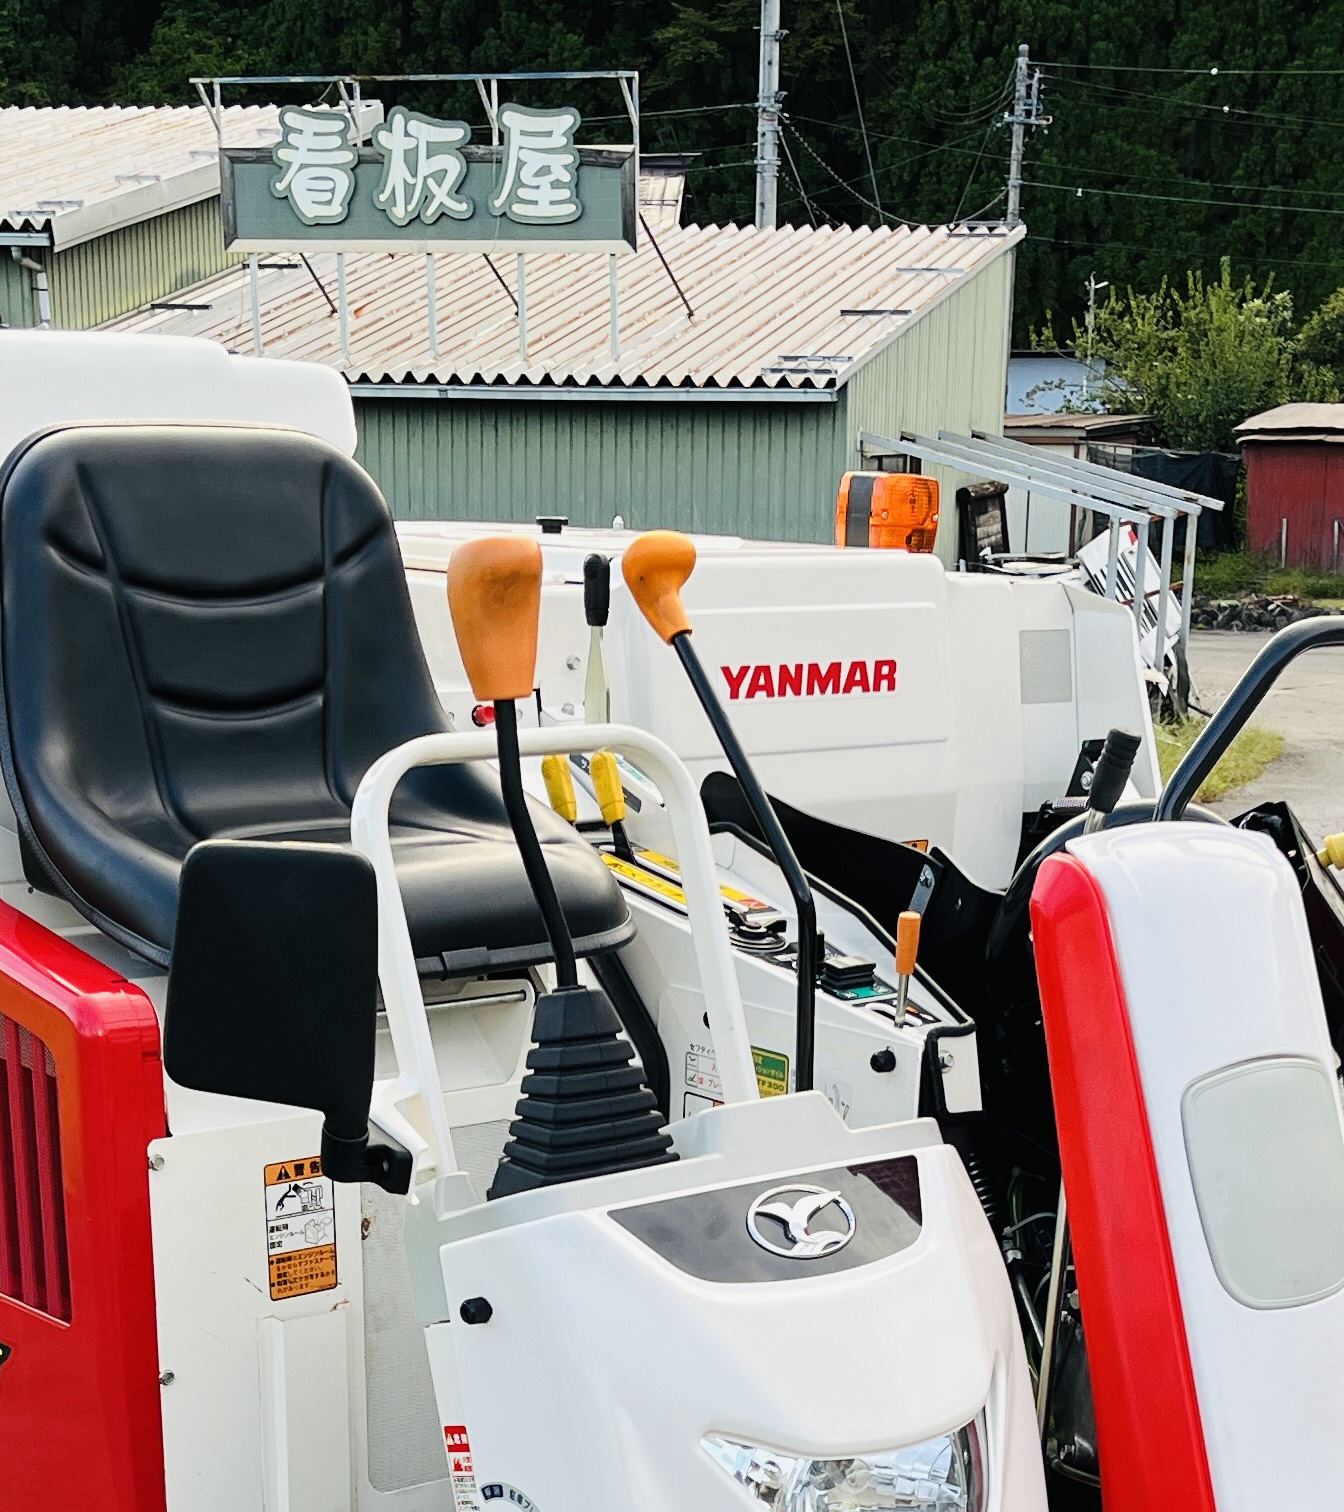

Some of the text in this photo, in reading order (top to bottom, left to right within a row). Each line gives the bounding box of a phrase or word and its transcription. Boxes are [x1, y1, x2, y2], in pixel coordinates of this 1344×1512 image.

[273, 106, 580, 223] 看板屋
[720, 658, 897, 701] YANMAR
